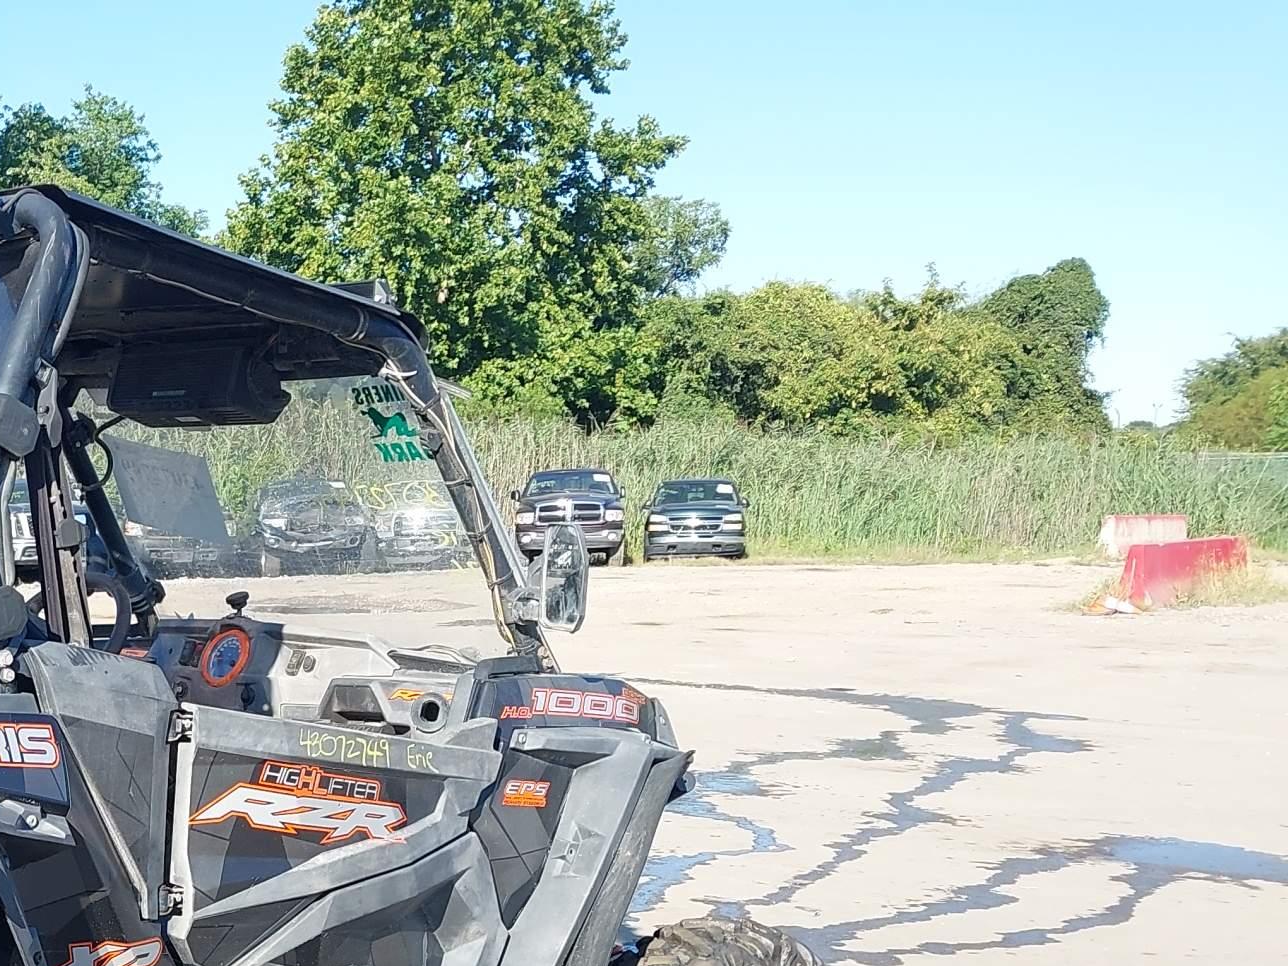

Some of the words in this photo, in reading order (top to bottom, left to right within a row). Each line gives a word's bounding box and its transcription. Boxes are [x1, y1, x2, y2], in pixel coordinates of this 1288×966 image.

[532, 689, 639, 724] 1000
[299, 728, 390, 767] 43072749
[408, 744, 439, 774] Erie
[505, 780, 550, 797] EPS
[189, 784, 406, 844] RZR
